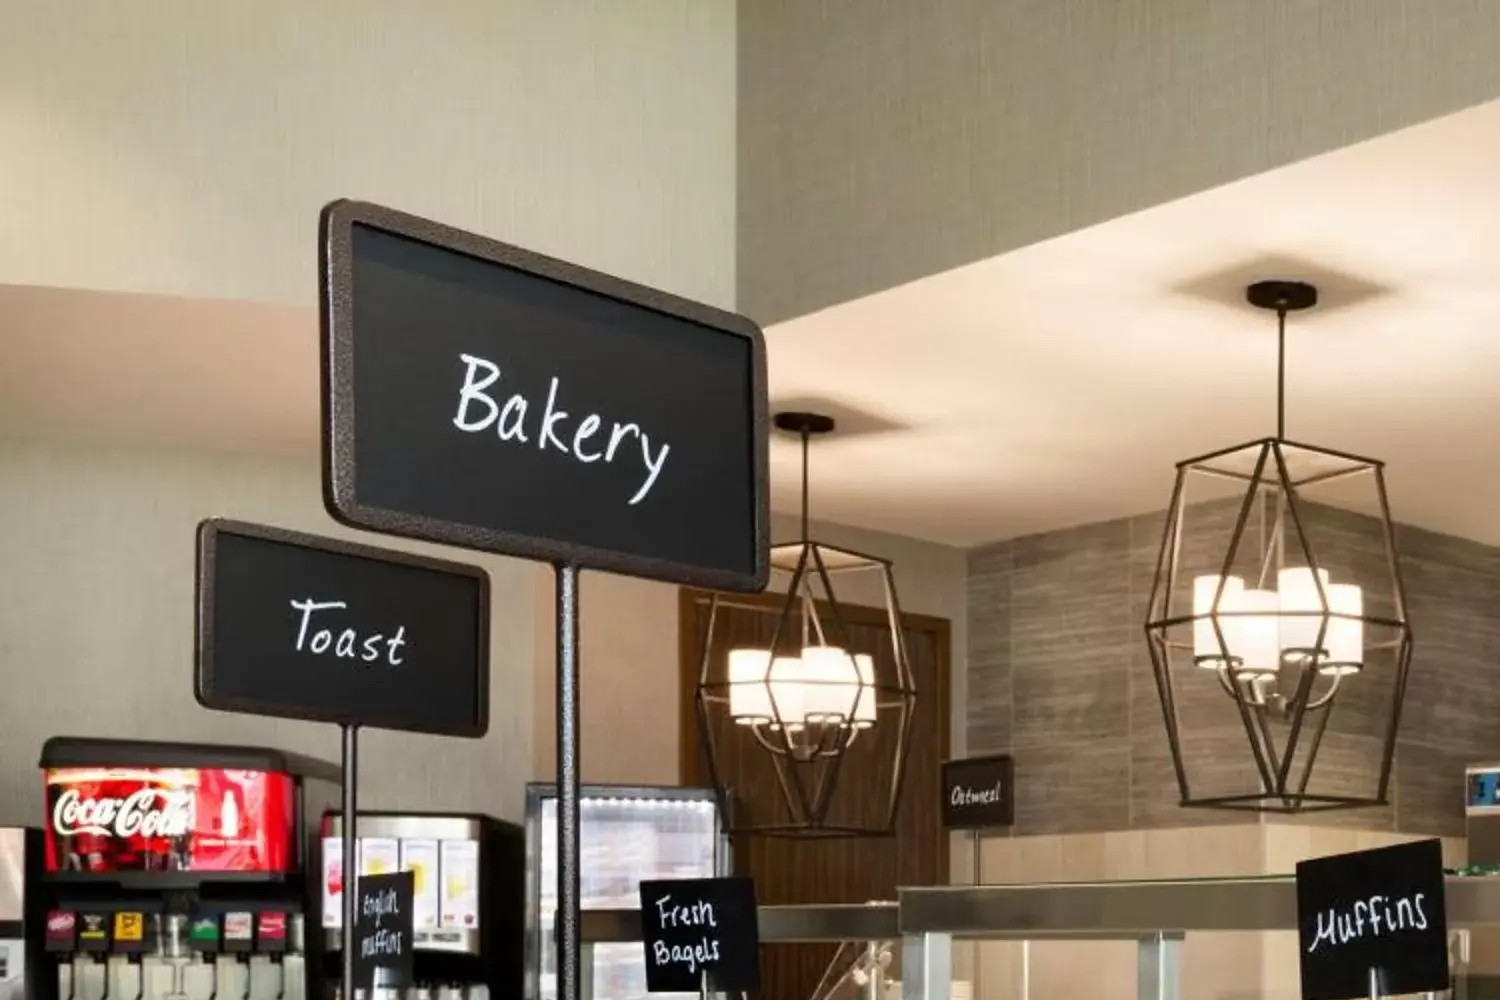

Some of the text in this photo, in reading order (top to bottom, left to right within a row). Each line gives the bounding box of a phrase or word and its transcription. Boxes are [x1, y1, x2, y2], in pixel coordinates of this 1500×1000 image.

[452, 352, 671, 505] Bakery
[290, 597, 408, 665] Toast
[656, 894, 717, 930] Fresh
[1308, 891, 1429, 953] Muffins
[653, 937, 720, 974] Bagels
